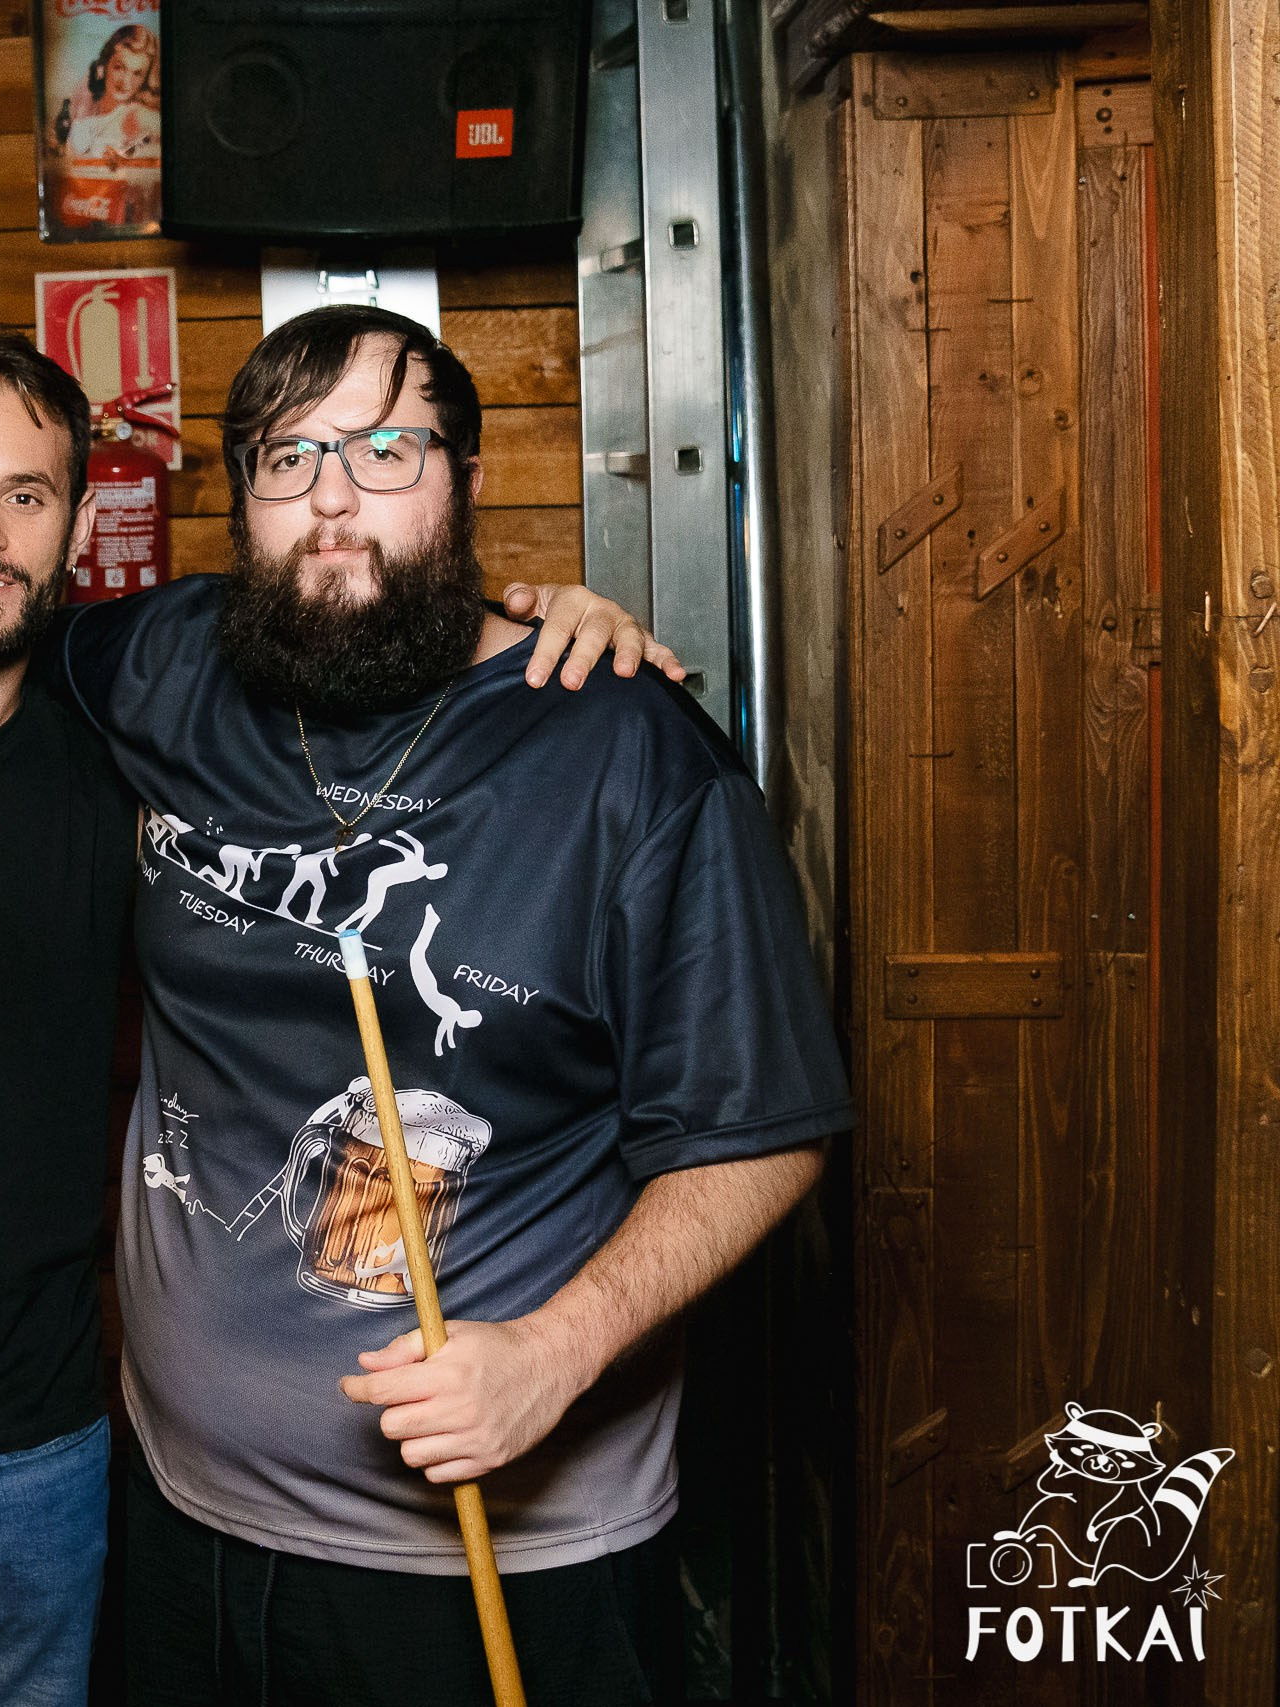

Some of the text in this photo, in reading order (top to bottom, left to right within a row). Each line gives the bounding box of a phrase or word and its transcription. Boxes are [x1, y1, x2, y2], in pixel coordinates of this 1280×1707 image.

[468, 123, 501, 145] JBL
[316, 782, 441, 812] WEDNESDAY
[179, 890, 256, 935] TUESDAY
[294, 942, 396, 986] THURAY
[453, 965, 540, 1005] FRIDAY
